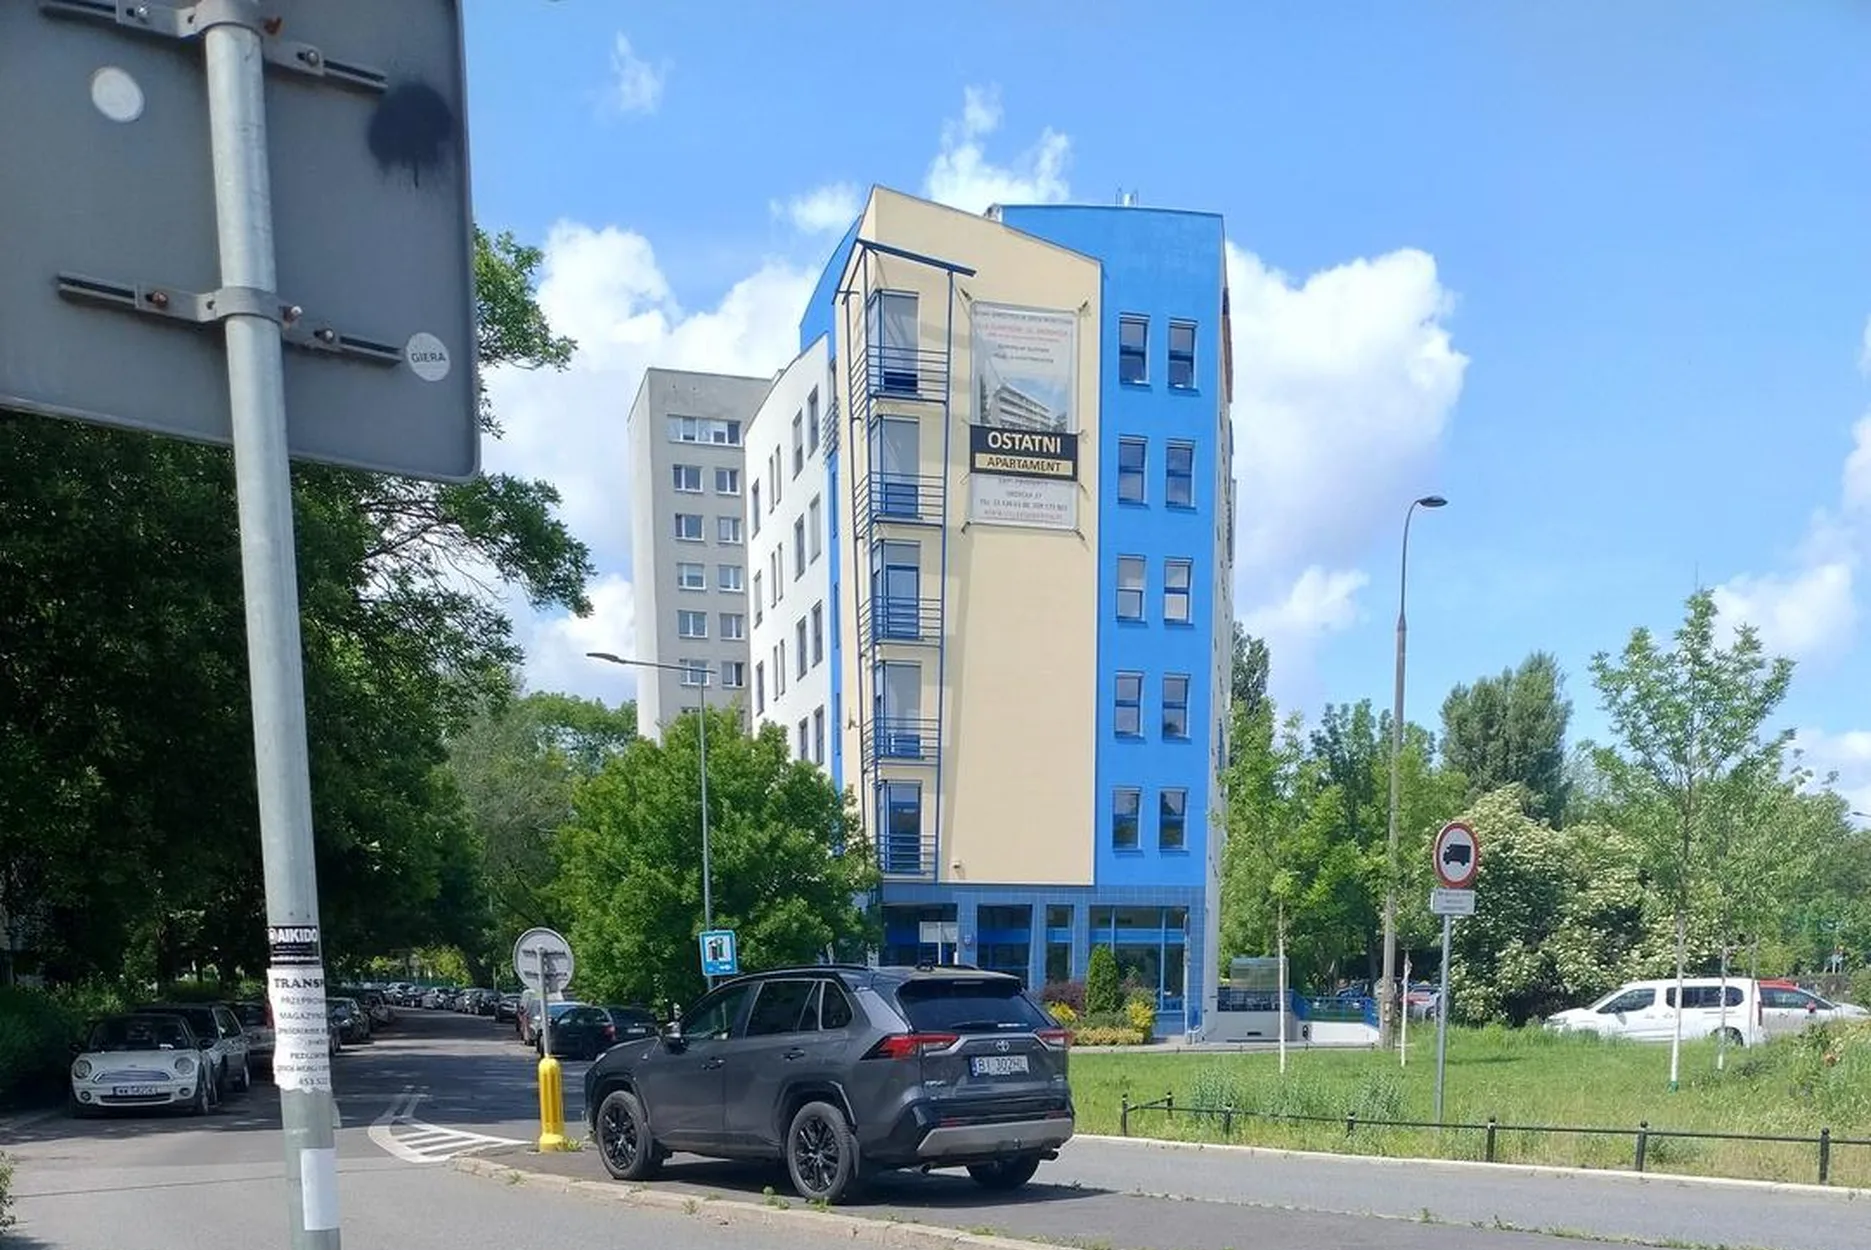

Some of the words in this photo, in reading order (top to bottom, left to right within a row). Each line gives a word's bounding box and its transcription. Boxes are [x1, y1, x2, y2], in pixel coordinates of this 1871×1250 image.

[411, 352, 446, 363] GIERA
[987, 431, 1061, 454] OSTATNI
[987, 456, 1062, 472] APARTAMENT
[277, 927, 318, 943] AIKIDO
